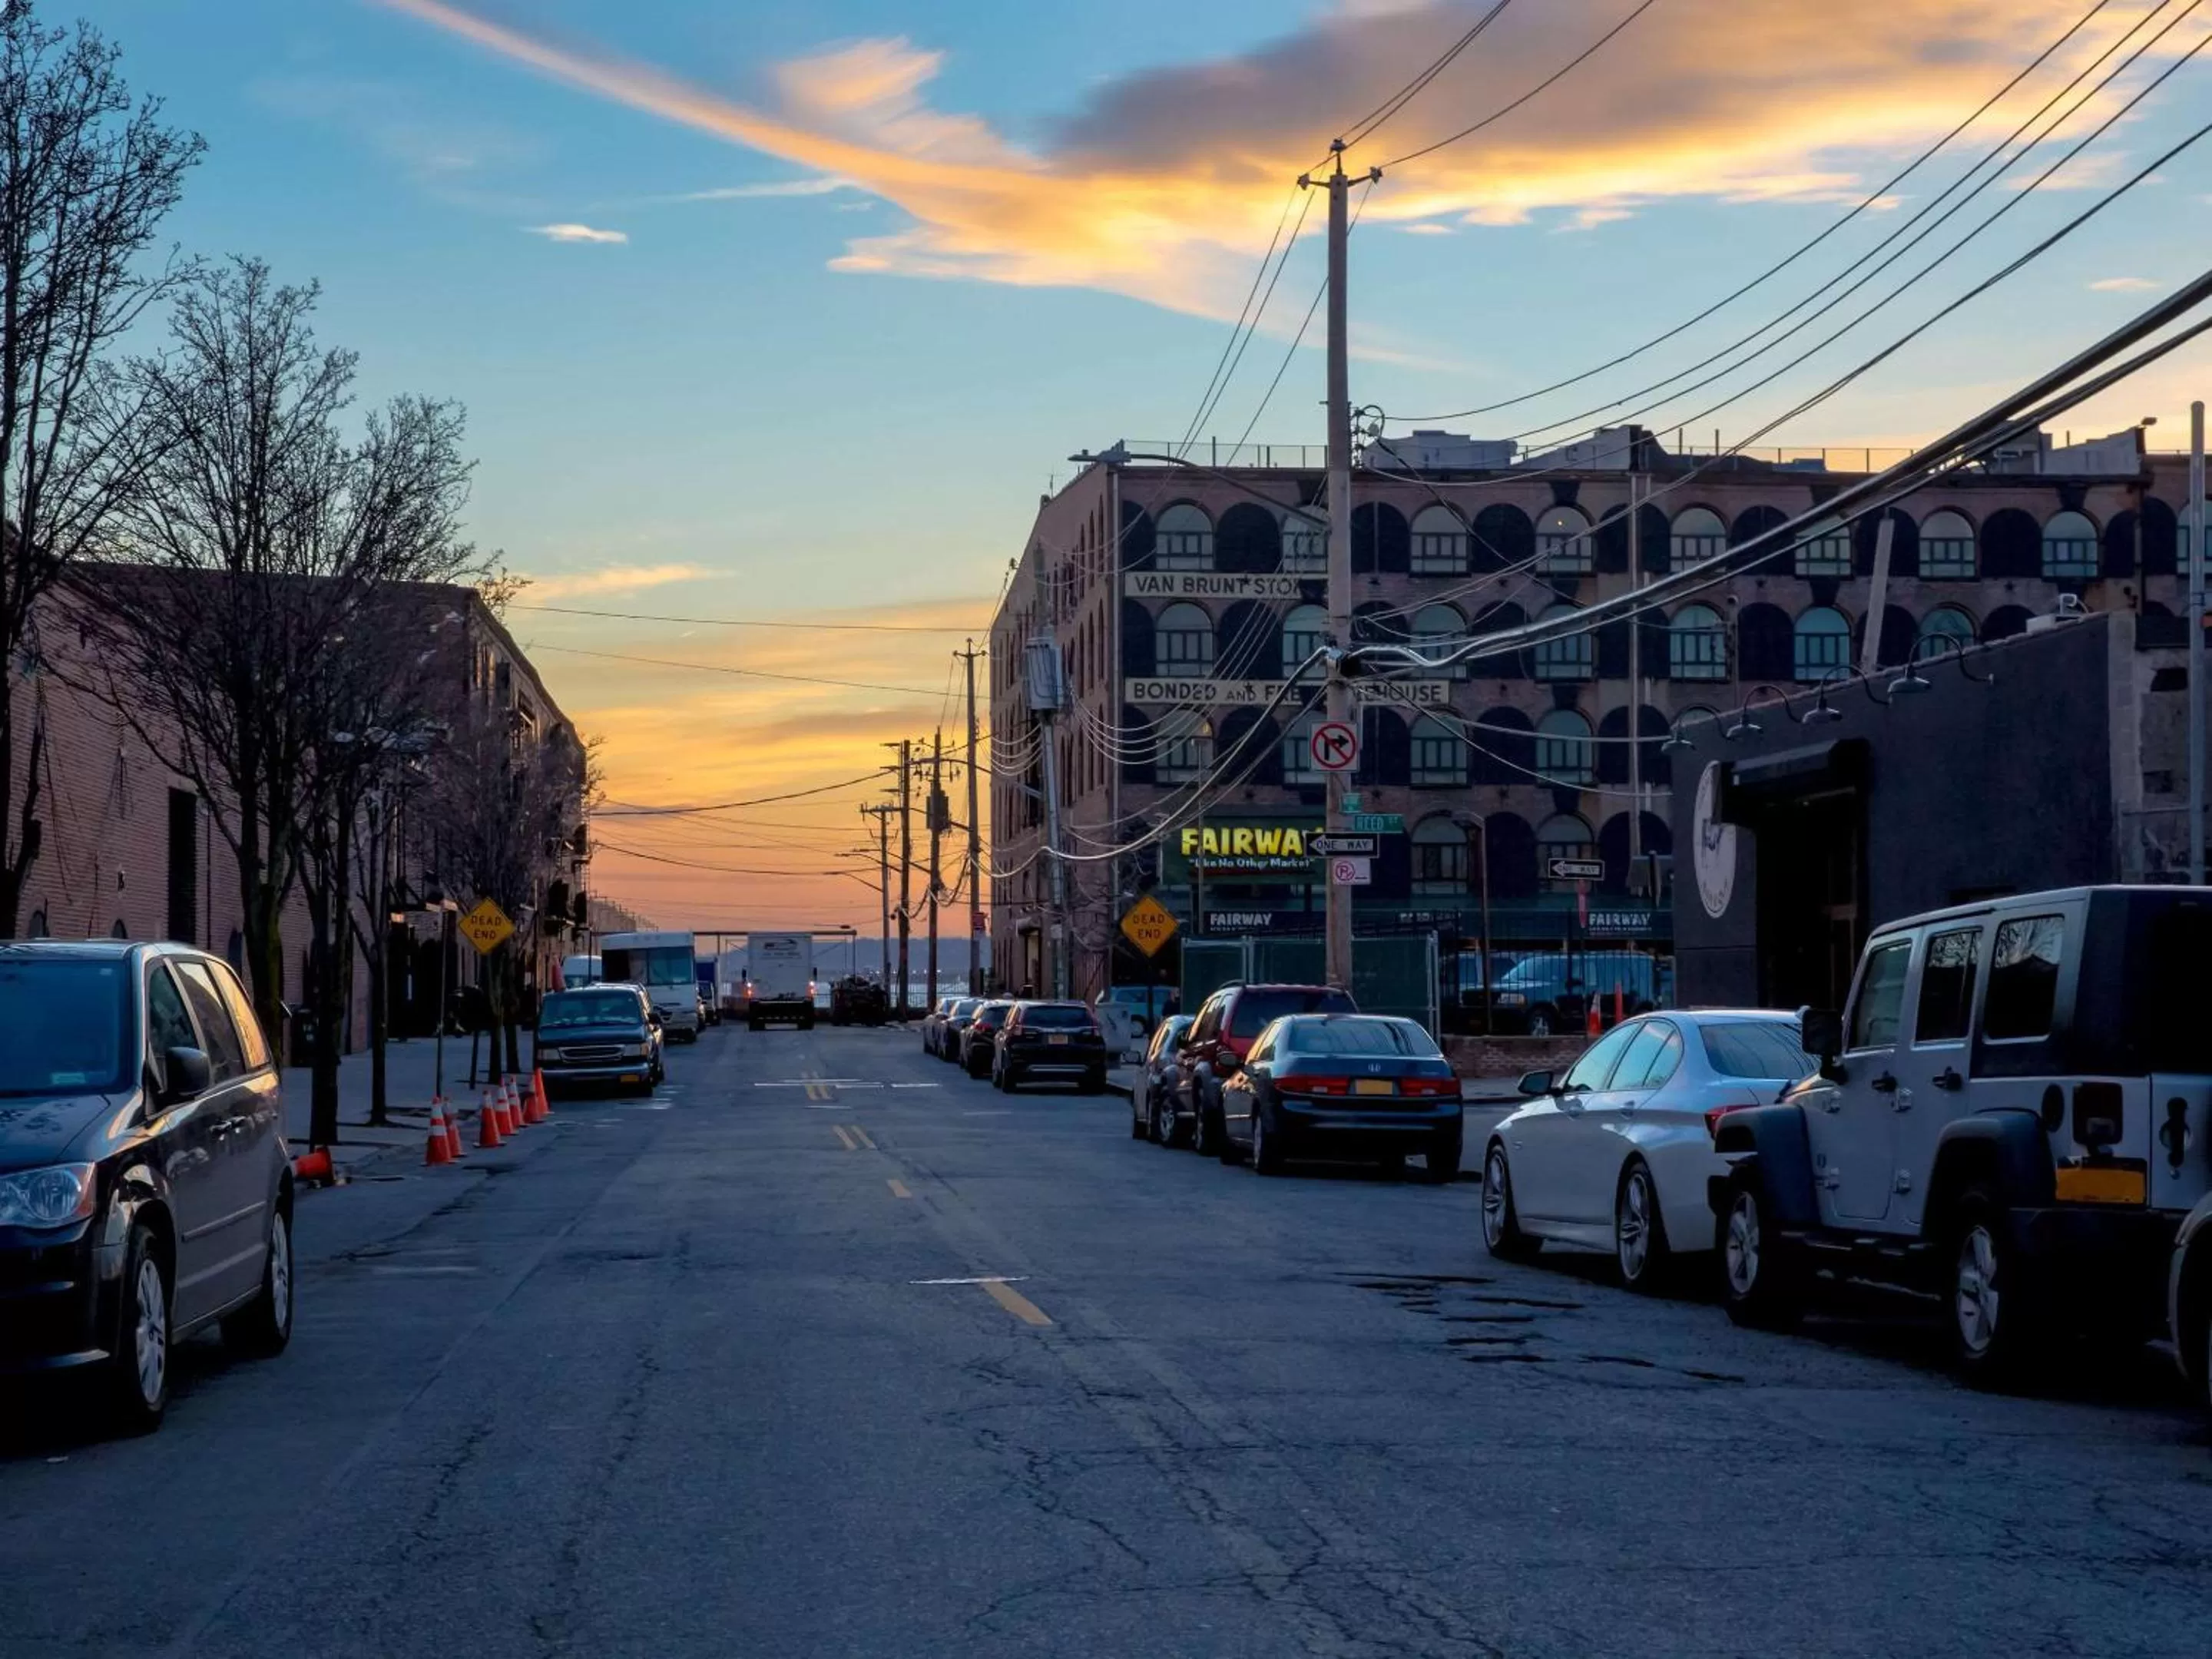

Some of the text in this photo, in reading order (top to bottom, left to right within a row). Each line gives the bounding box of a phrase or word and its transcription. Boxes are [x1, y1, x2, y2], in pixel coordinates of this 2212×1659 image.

[1134, 575, 1175, 593] VAN
[1182, 576, 1246, 594] BRUNT
[1133, 683, 1216, 700] BONDED
[1227, 689, 1256, 700] AND
[1181, 826, 1324, 856] FAIRWA
[1316, 840, 1368, 849] ONE WAY
[1218, 858, 1234, 868] No
[1237, 858, 1268, 869] Other
[472, 915, 501, 926] DEAD
[1132, 913, 1164, 925] DEAD
[1210, 912, 1272, 926] FAIRWAY
[1588, 912, 1651, 926] FAIRWAY
[473, 929, 496, 940] END
[1137, 929, 1161, 939] END
